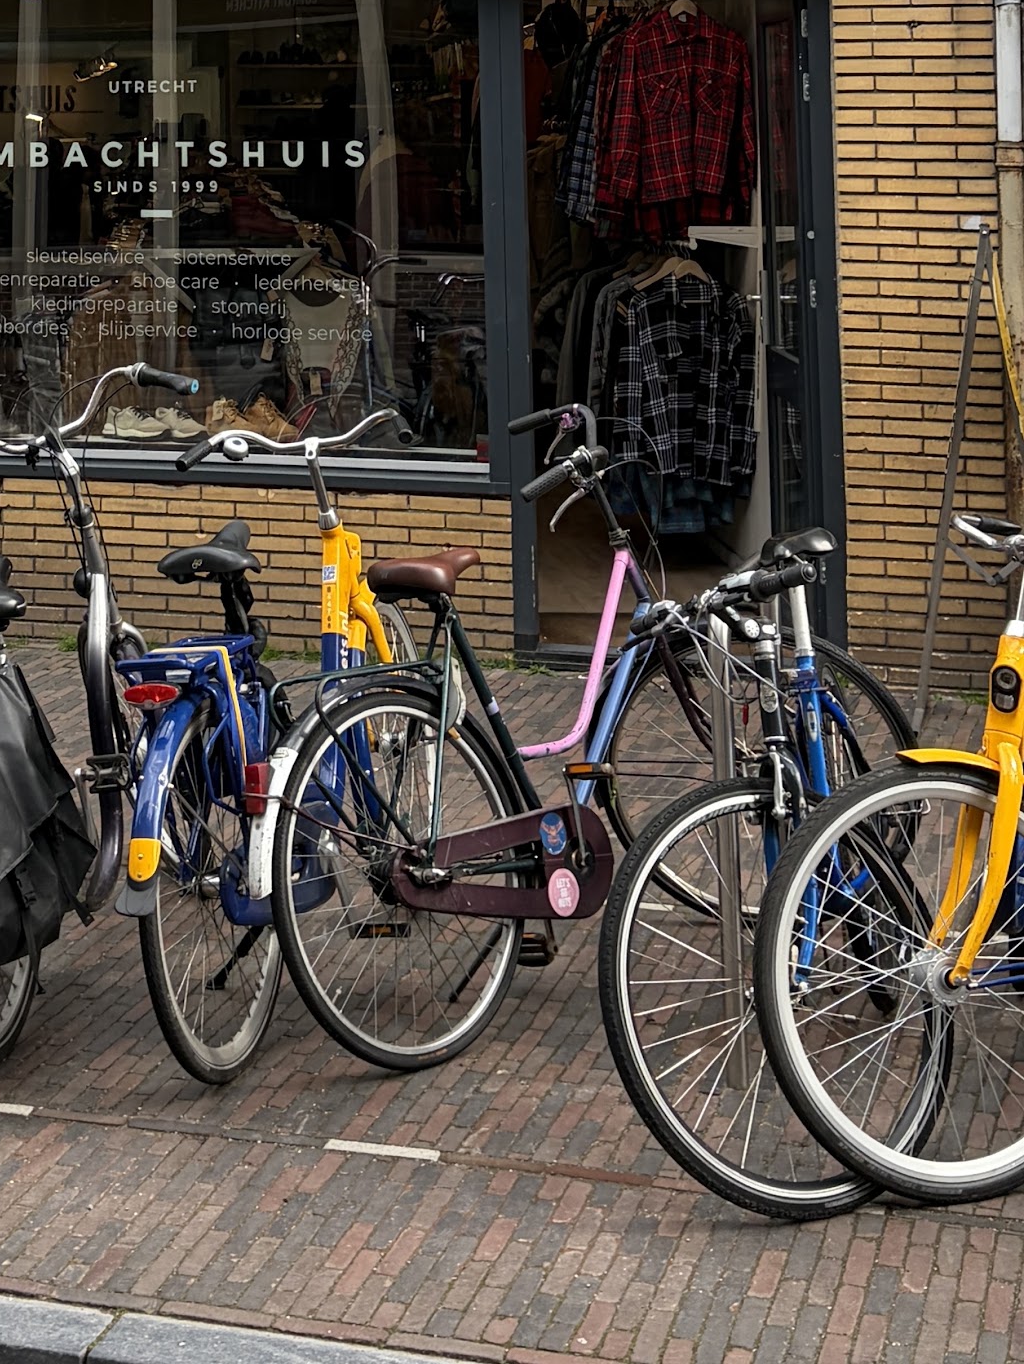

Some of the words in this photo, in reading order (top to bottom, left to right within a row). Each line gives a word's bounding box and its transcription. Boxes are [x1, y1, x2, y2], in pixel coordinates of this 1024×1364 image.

[108, 79, 198, 94] UTRECHT
[93, 180, 159, 193] SINDS
[171, 179, 219, 193] 1999
[26, 247, 145, 265] sleutelservice
[174, 249, 292, 266] slotenservice
[133, 272, 176, 289] shoe
[180, 276, 220, 289] care
[254, 273, 364, 292] lederherstel
[31, 295, 178, 315] kledingreparatie
[211, 299, 287, 318] stomerij
[100, 321, 198, 340] slijpservice
[231, 323, 303, 344] horloge
[308, 325, 374, 342] service
